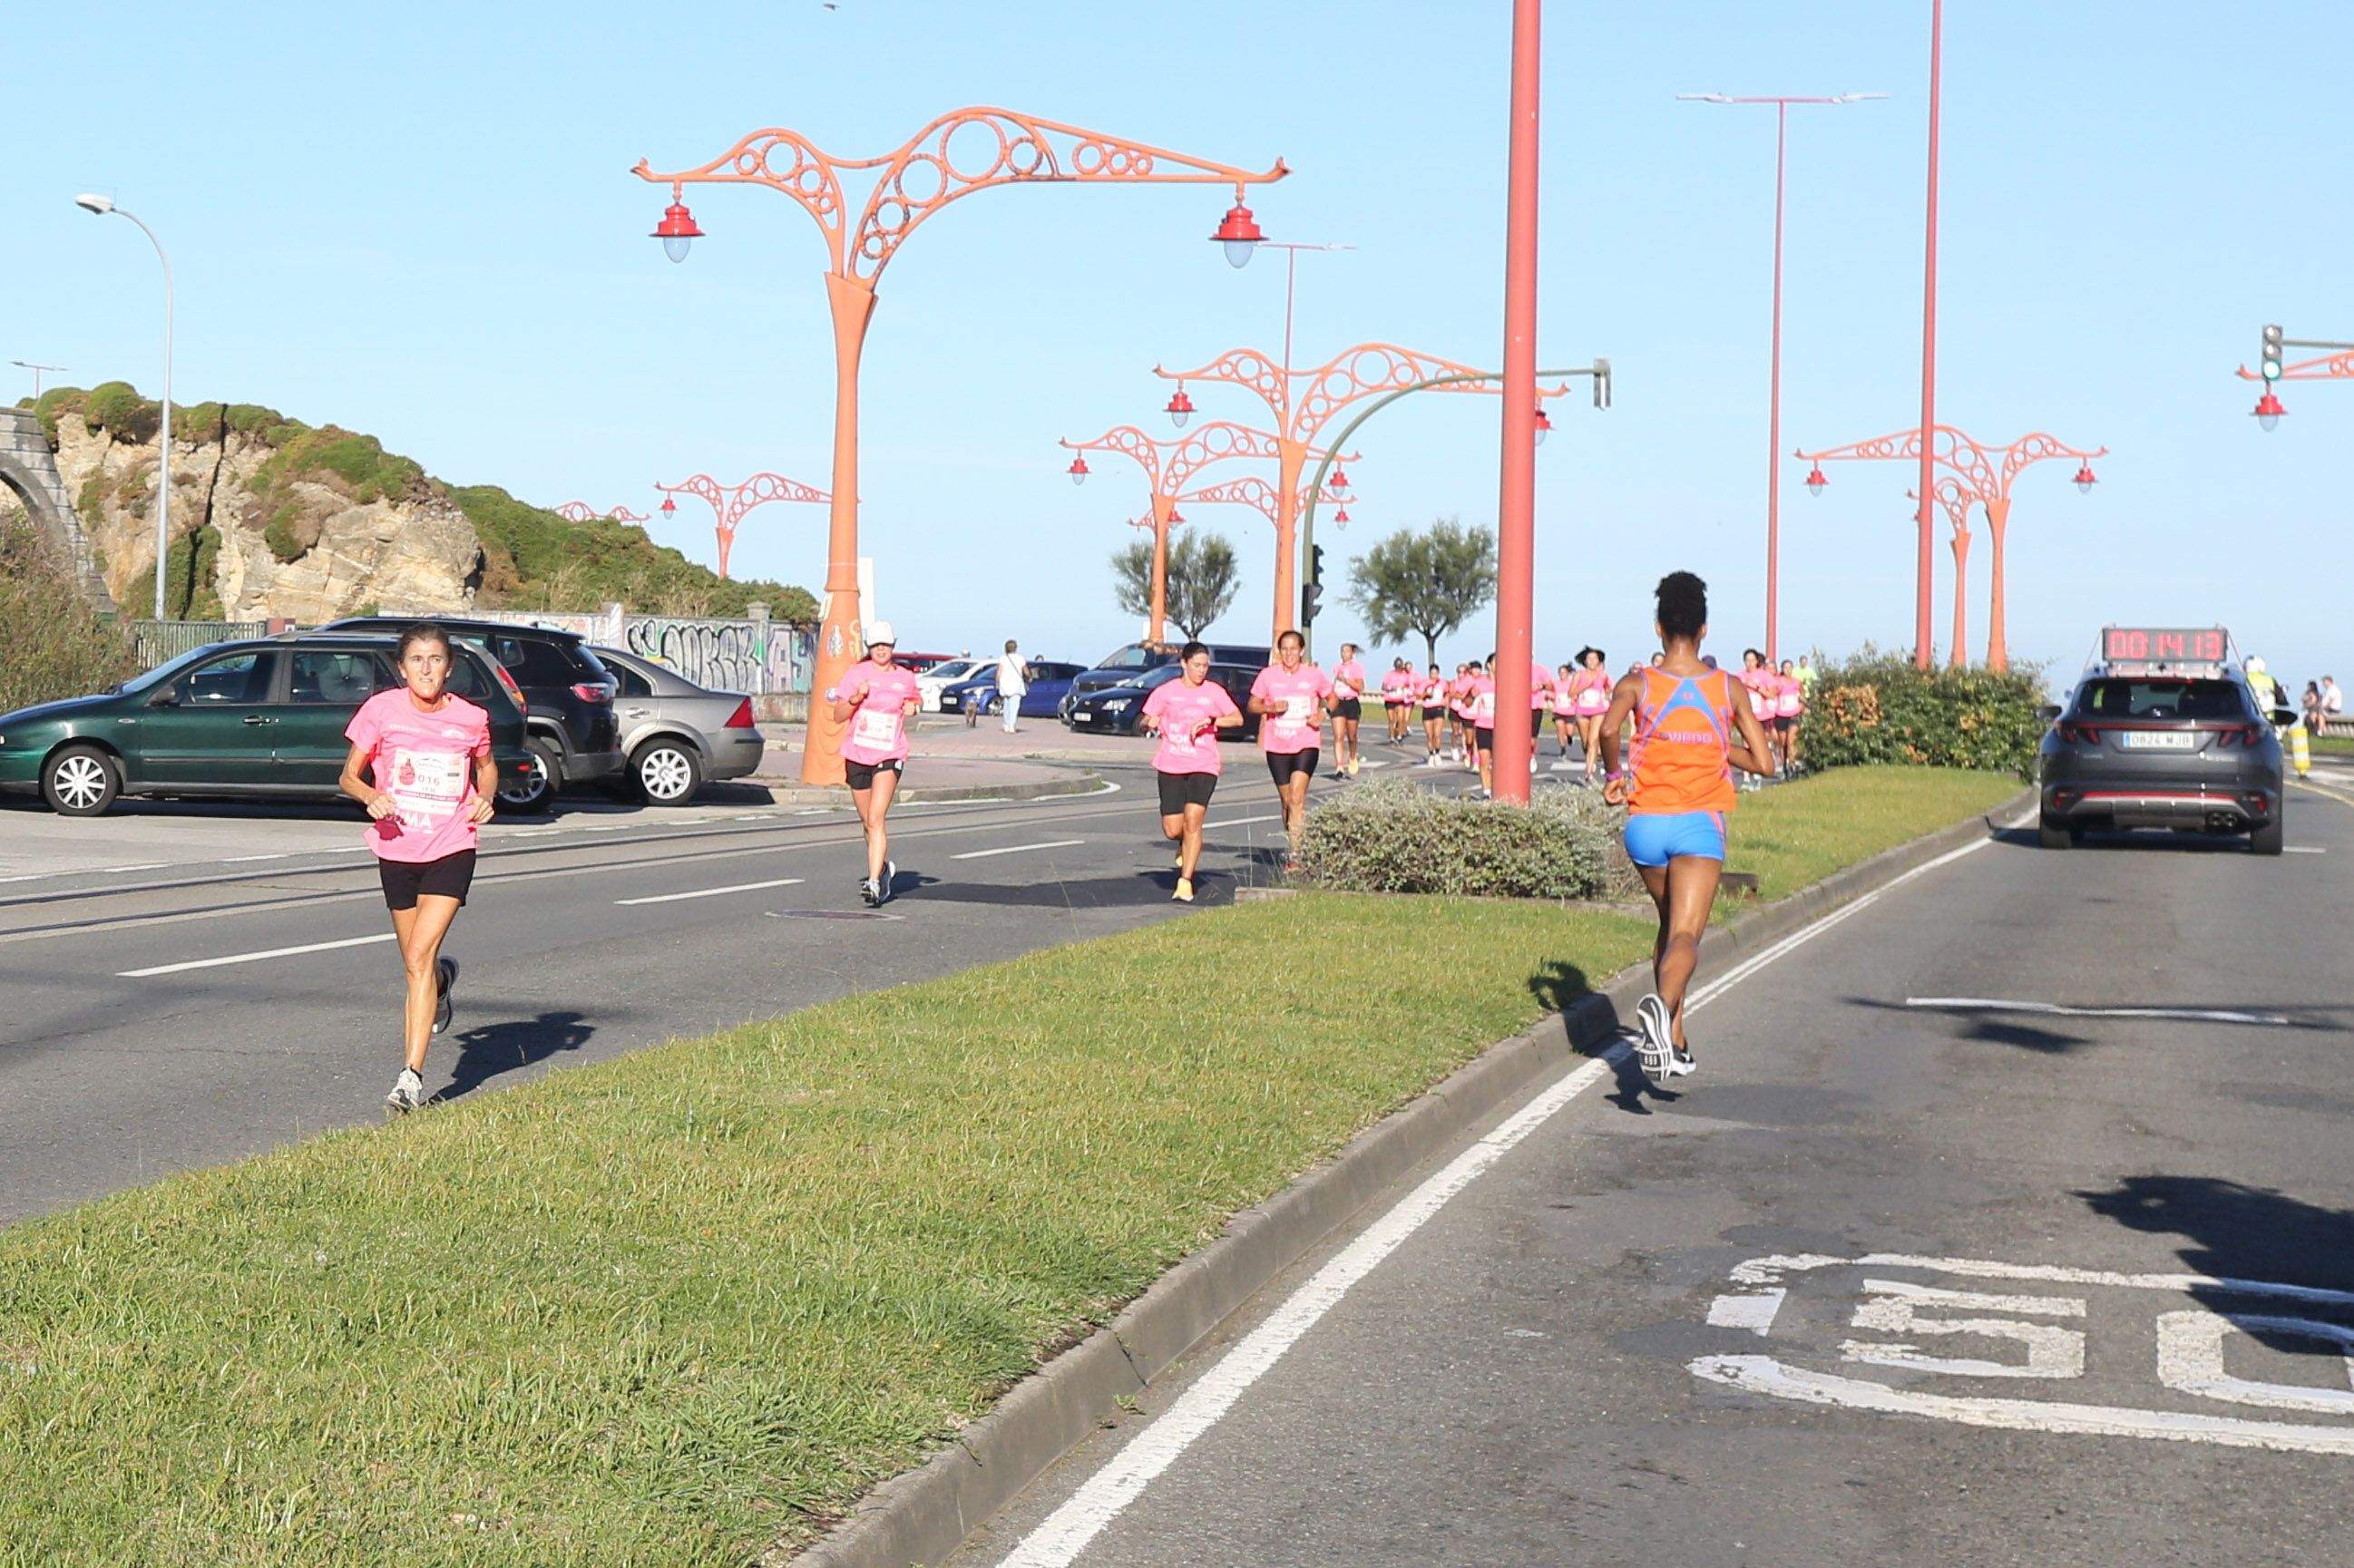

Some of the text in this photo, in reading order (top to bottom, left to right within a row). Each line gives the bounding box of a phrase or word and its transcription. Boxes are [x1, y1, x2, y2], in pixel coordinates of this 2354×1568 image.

[2157, 631, 2183, 658] 14
[2194, 630, 2222, 661] 13
[1836, 1279, 2354, 1412] 50
